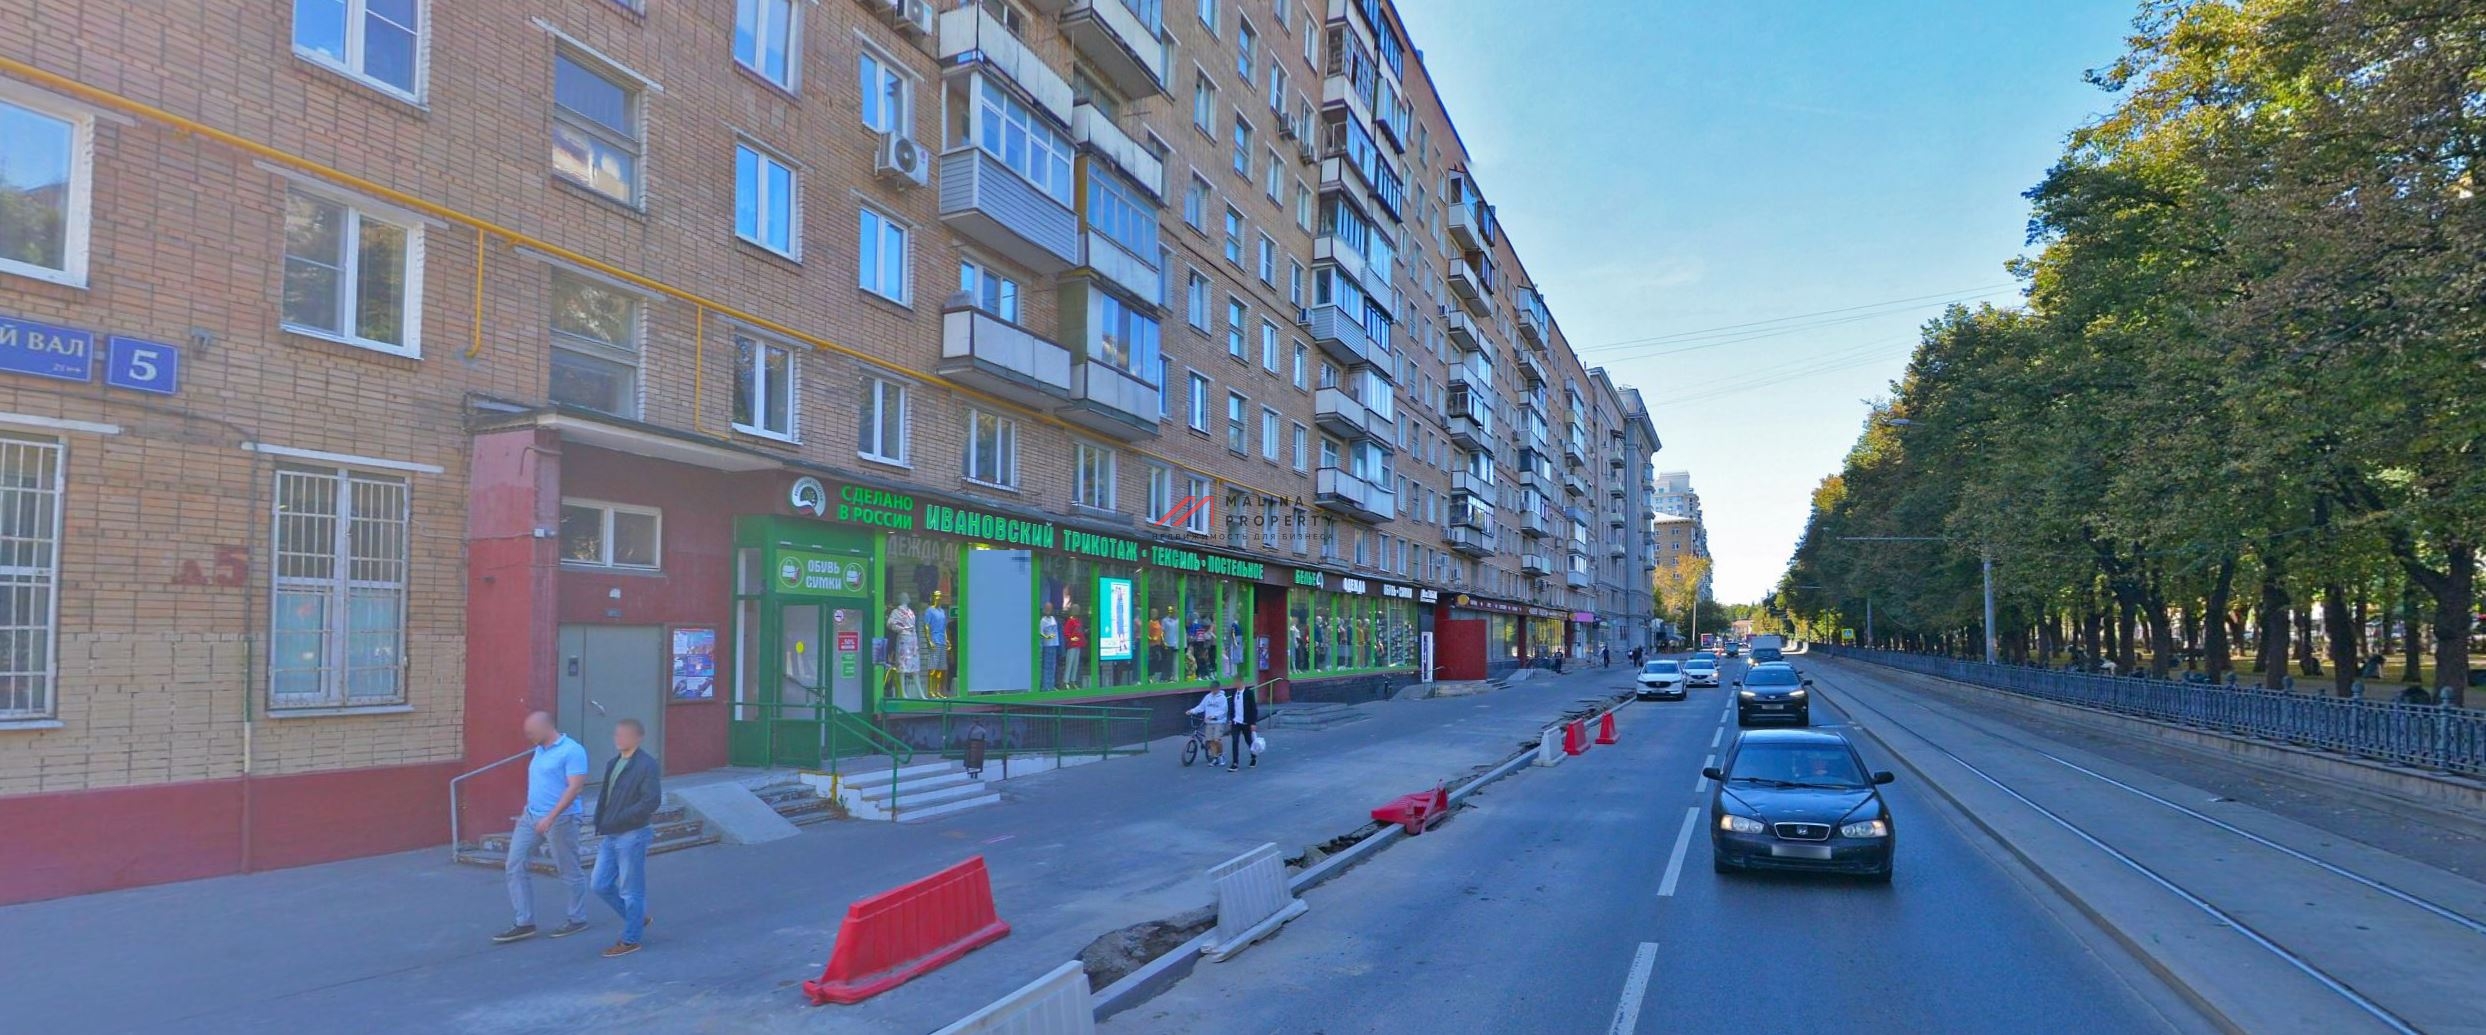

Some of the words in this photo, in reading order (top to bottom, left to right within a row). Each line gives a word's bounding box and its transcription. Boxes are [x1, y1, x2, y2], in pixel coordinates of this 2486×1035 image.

[27, 331, 85, 358] ВАЛ
[129, 349, 160, 382] 5
[841, 485, 914, 512] СДЕЛАНО
[838, 504, 849, 521] В
[852, 507, 913, 530] РОССИИ
[926, 504, 1054, 549] ИВАНОВСКИЙ
[1063, 529, 1138, 563] ТРИКОТАЖ
[1207, 554, 1265, 580] ПОСТЕЛЬНОЕ
[807, 559, 841, 574] ОБУВЬ
[805, 575, 842, 591] СУМКИ
